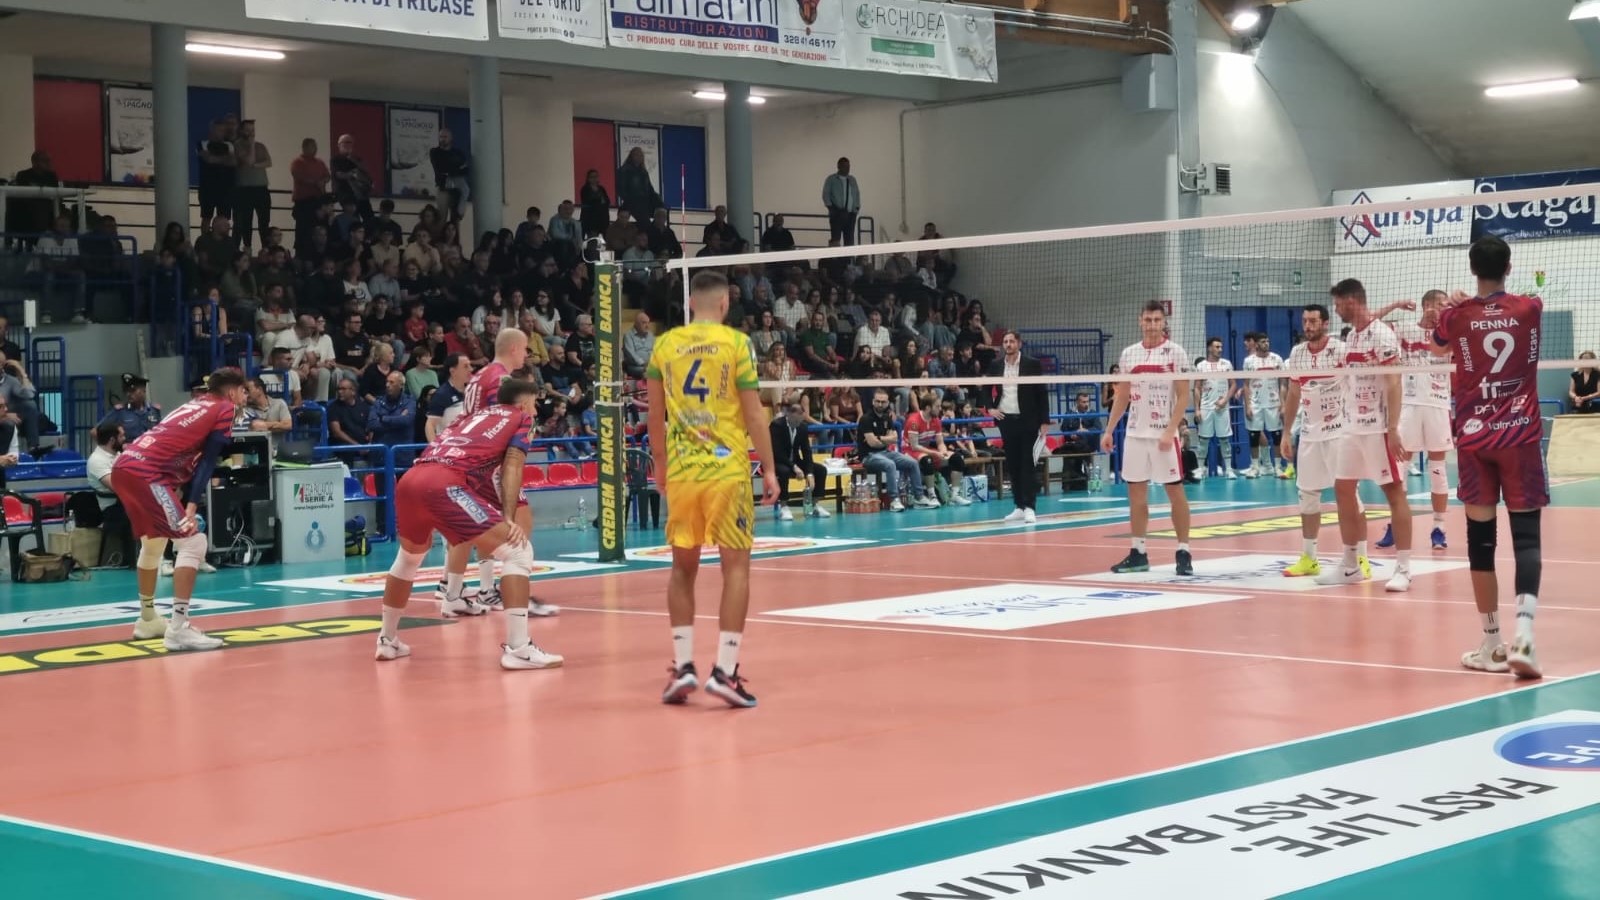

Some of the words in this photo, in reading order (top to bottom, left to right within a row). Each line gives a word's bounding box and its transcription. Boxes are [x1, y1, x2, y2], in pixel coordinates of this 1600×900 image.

[624, 15, 769, 39] RISTRUTTURAZIONI
[637, 36, 675, 46] PRENDIAMO
[680, 38, 695, 48] CURA
[697, 41, 719, 50] DELLE
[723, 42, 750, 51] VOSTRE
[599, 274, 613, 333] BANCA
[1470, 317, 1520, 331] PENNA
[1459, 336, 1475, 373] Alessano
[1483, 331, 1515, 374] 9
[1528, 327, 1538, 365] Tricase
[682, 359, 710, 403] 4
[601, 416, 615, 476] BANCA
[305, 495, 326, 503] SERIE
[327, 494, 333, 502] A
[602, 482, 616, 550] CREDEM
[1208, 786, 1379, 832] FAST
[1396, 777, 1559, 822] FAST
[1230, 812, 1391, 858] LIFE.
